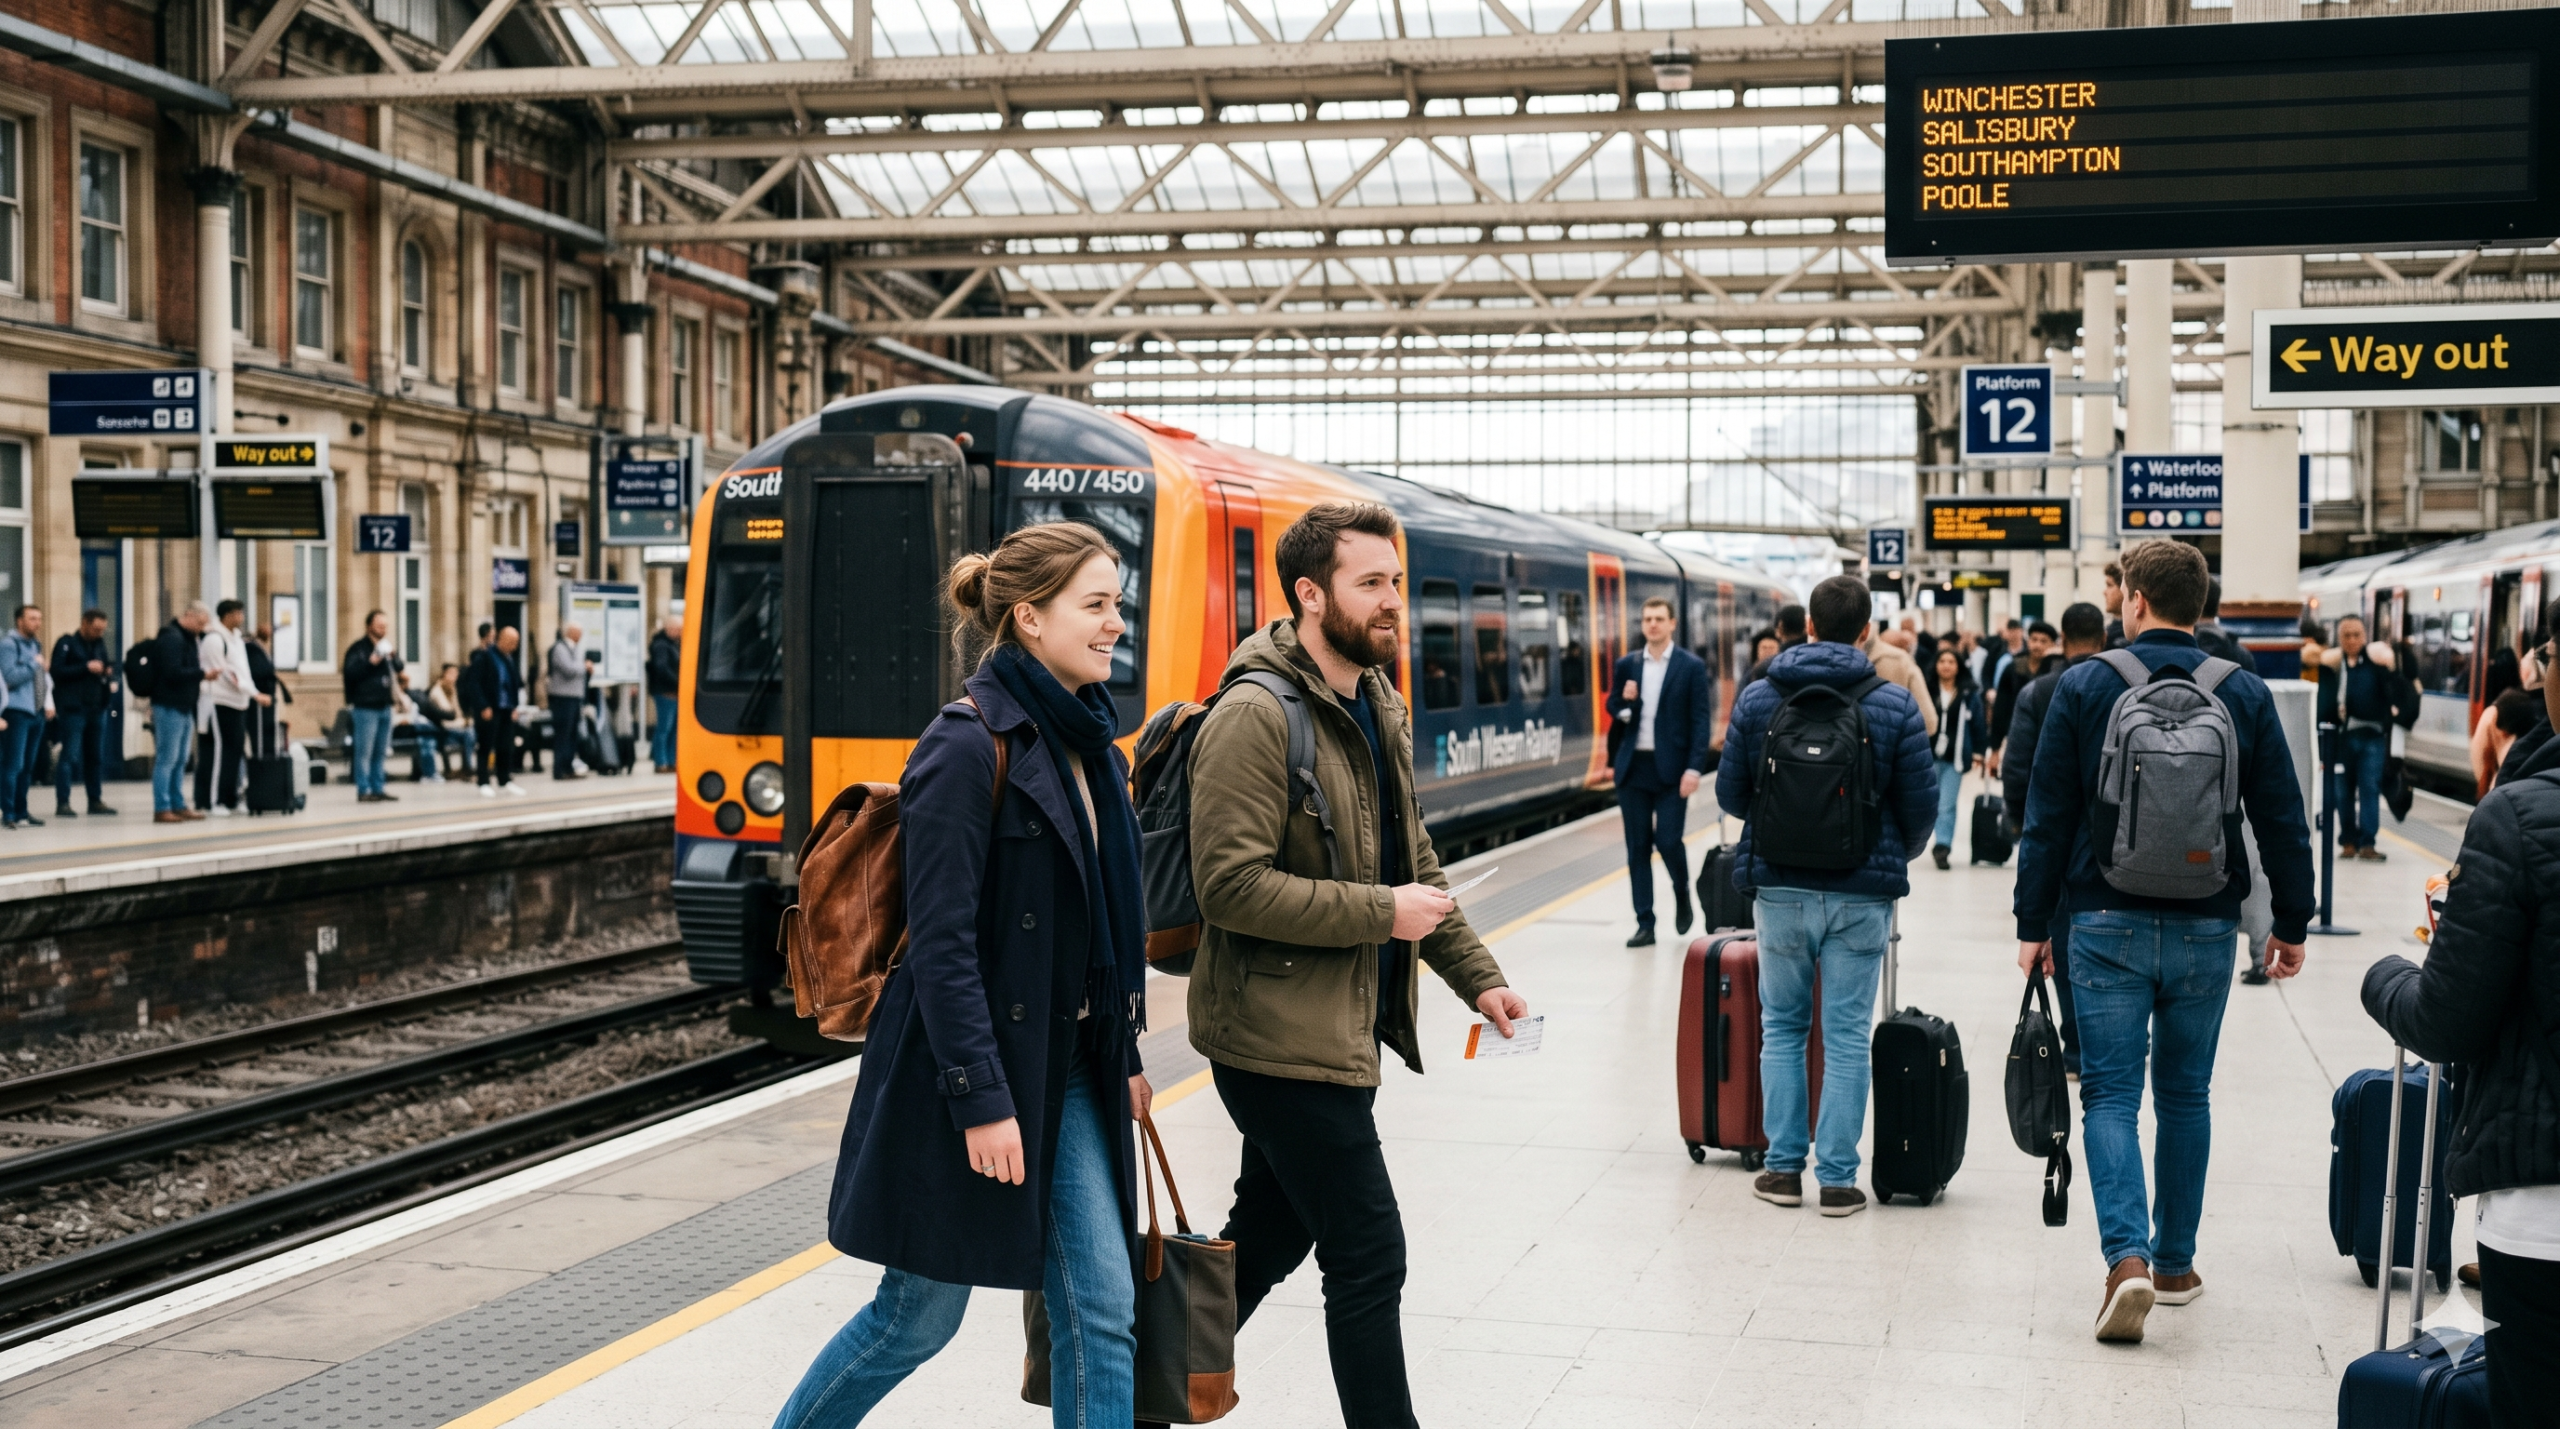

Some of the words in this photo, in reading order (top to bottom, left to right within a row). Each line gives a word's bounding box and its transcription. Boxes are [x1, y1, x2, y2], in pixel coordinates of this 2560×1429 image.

[1923, 82, 2096, 113] WINCHESTER
[1923, 115, 2076, 146] SALISBURY
[1923, 146, 2120, 178] SOUTHAMPTON
[1923, 183, 2010, 211] POOLE
[2329, 336, 2424, 380] Way
[2433, 333, 2509, 371] out
[1975, 375, 2041, 391] Platform
[1979, 397, 2037, 443] 12
[233, 444, 267, 466] Way
[269, 444, 298, 463] out
[2147, 459, 2222, 477] Waterloo
[2147, 481, 2219, 499] Platform
[370, 526, 397, 549] 12
[1876, 539, 1900, 562] 12
